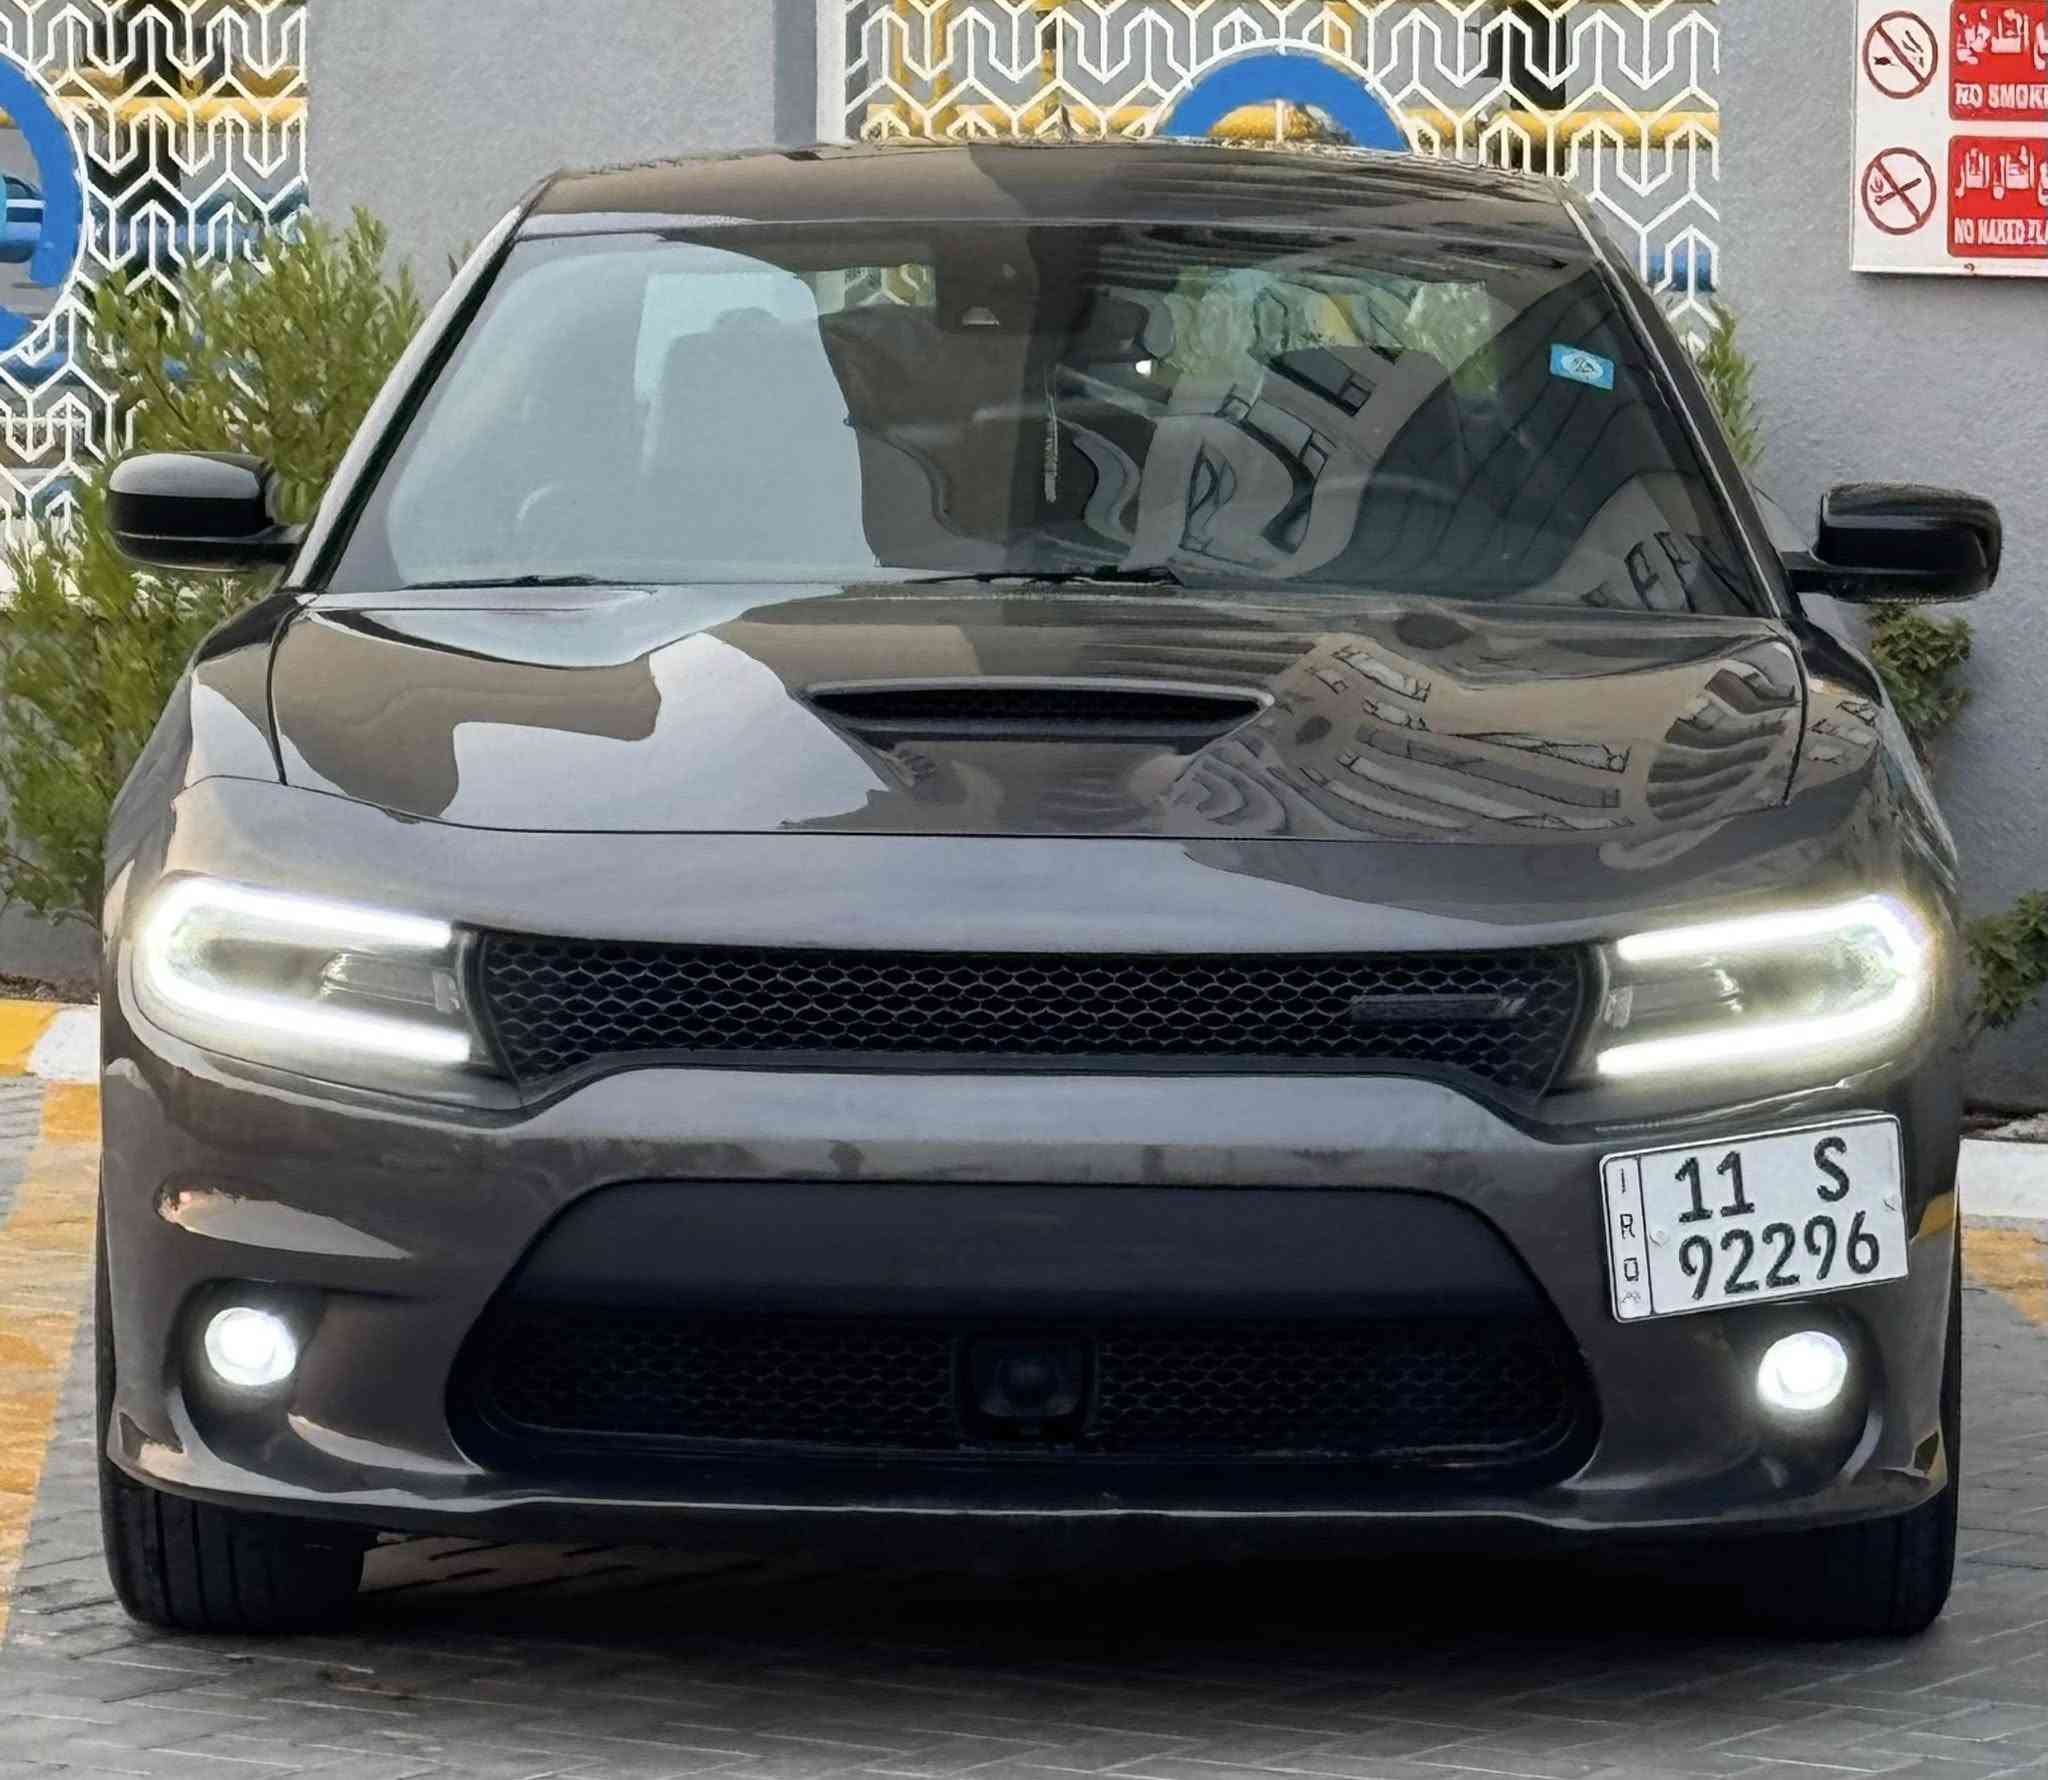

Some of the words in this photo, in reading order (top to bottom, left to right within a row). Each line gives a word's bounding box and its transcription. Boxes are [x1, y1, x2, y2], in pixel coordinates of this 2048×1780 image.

[1955, 83, 1983, 108] NO
[1954, 217, 1974, 244] NO
[2028, 219, 2048, 246] FL
[1675, 1150, 1755, 1223] 11
[1814, 1136, 1850, 1202] S
[1678, 1210, 1880, 1300] 92296
